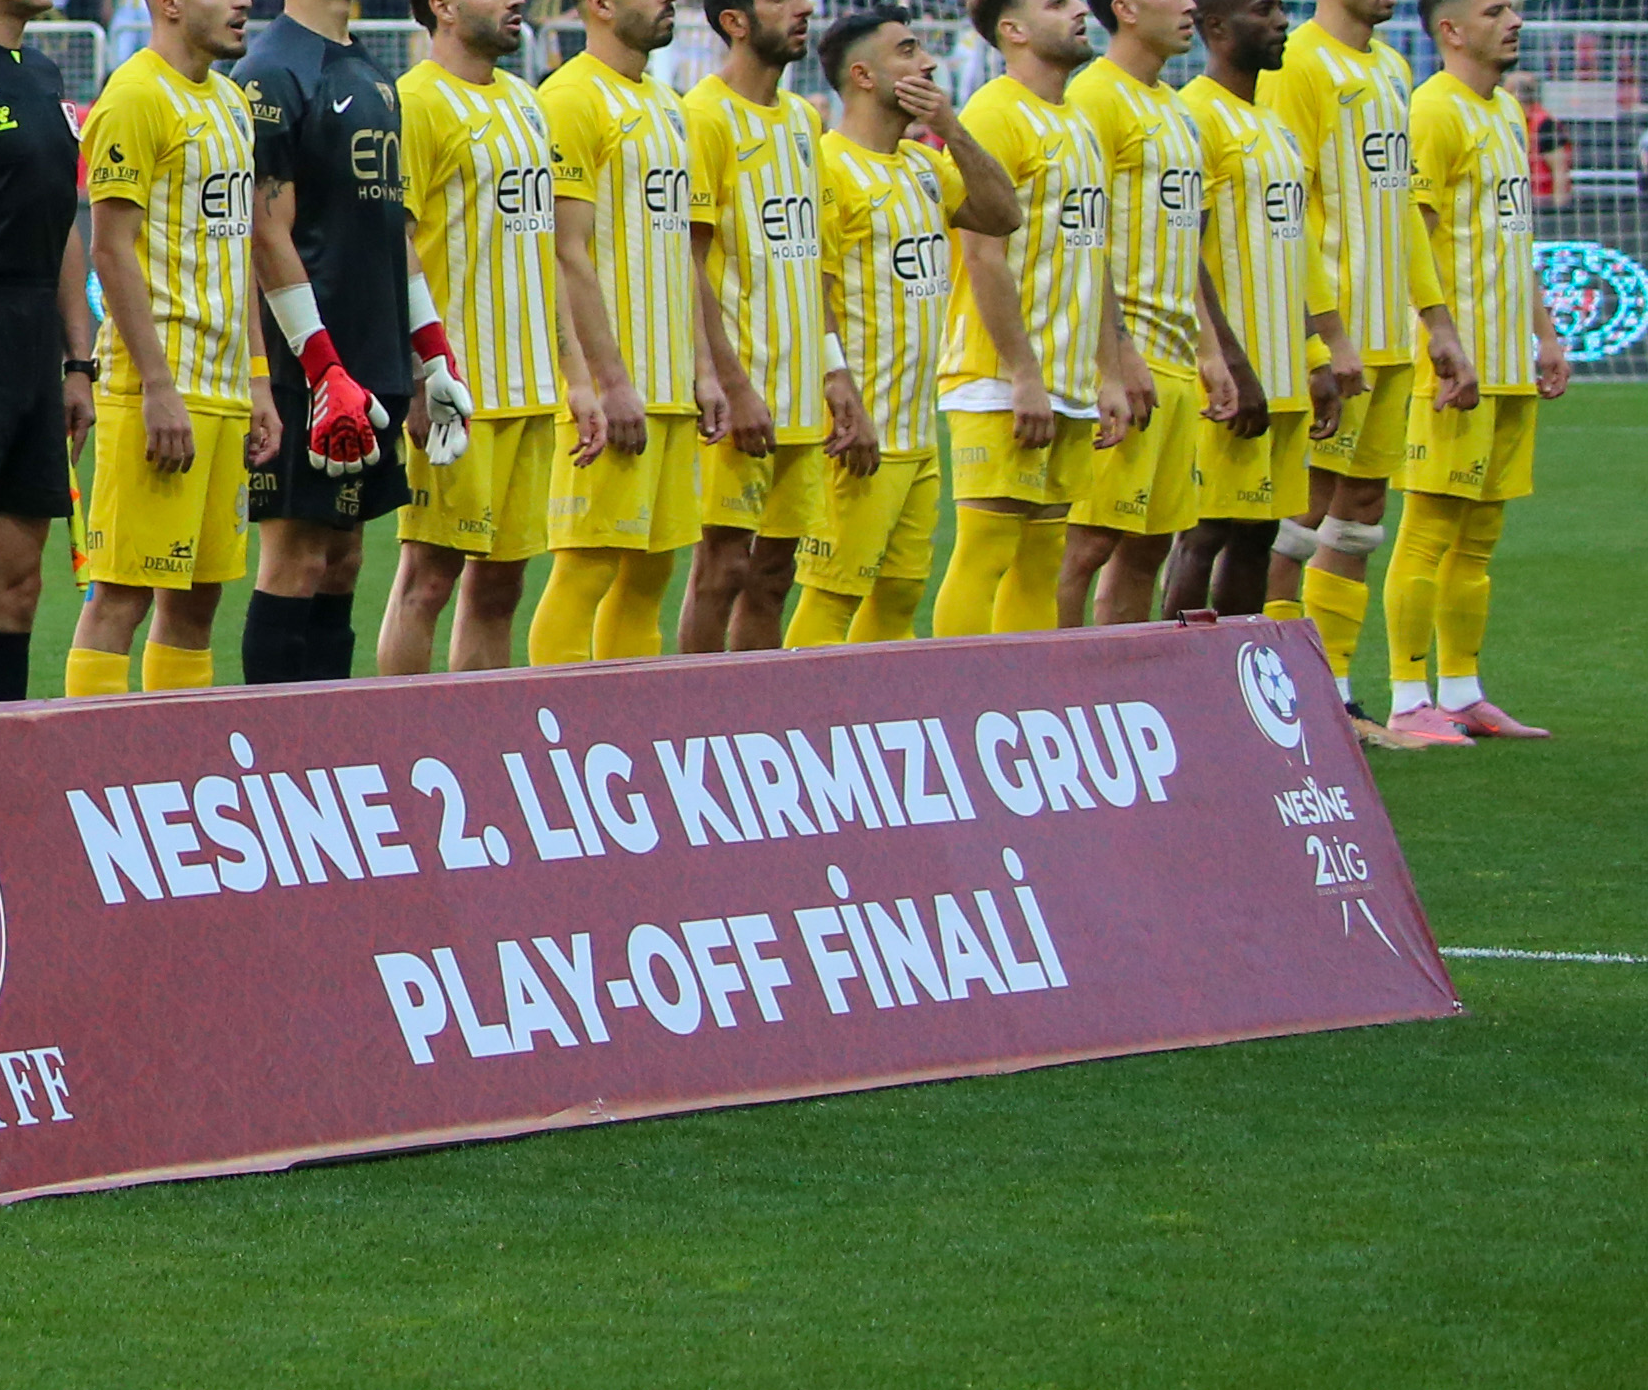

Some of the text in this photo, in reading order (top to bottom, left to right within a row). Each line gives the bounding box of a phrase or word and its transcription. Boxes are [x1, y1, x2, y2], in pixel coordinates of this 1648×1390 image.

[252, 103, 283, 119] YAPI
[559, 166, 584, 179] YAPI
[65, 700, 1178, 906] NESİNE 2. LİG KIRMIZI GRUP
[1273, 775, 1356, 827] NESİNE
[372, 845, 1069, 1066] PLAY-OFF FİNALİ
